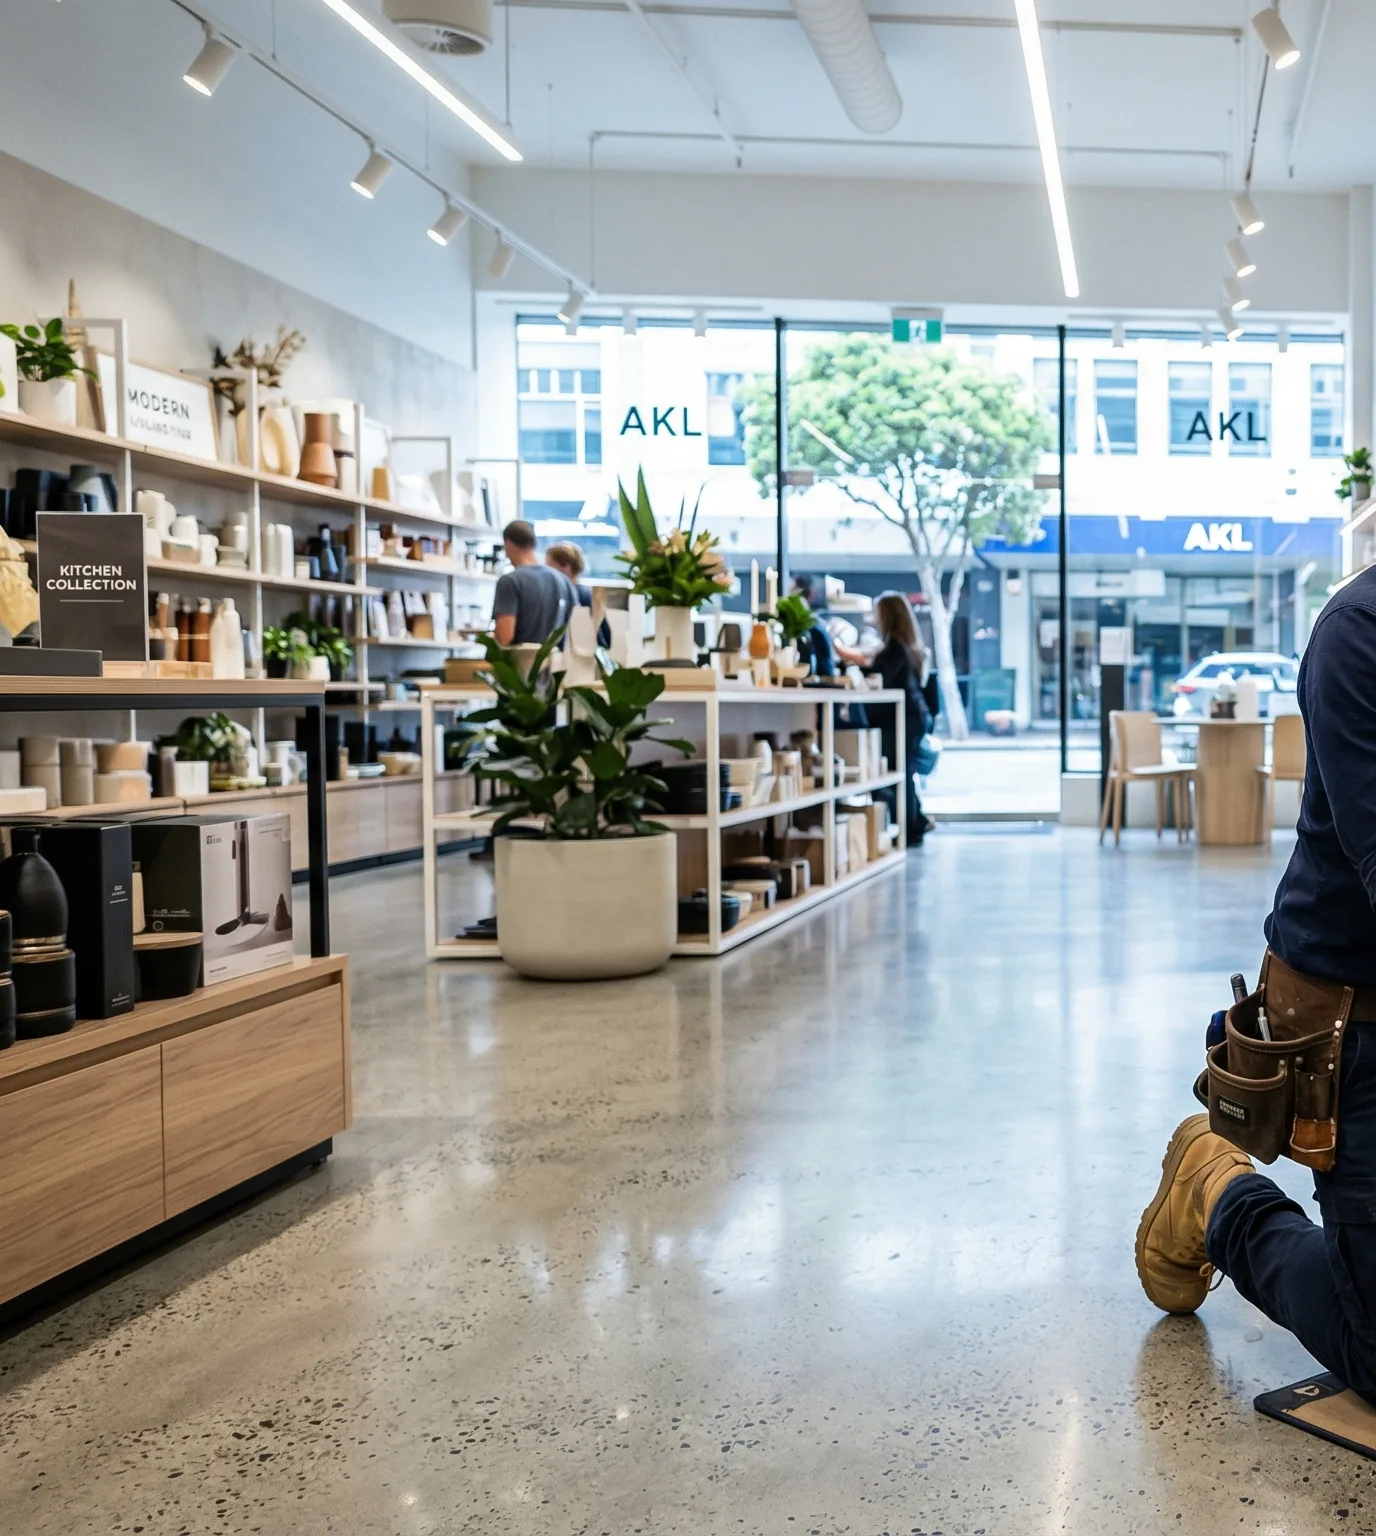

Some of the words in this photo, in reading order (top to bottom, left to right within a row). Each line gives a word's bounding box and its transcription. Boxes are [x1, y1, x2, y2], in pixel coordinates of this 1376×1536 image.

[128, 387, 190, 420] MODERN
[619, 405, 702, 436] AKL
[1186, 411, 1267, 441] AKL
[1183, 523, 1254, 552] AKL
[46, 579, 137, 591] COLLECTION
[59, 565, 122, 576] KITCHEN
